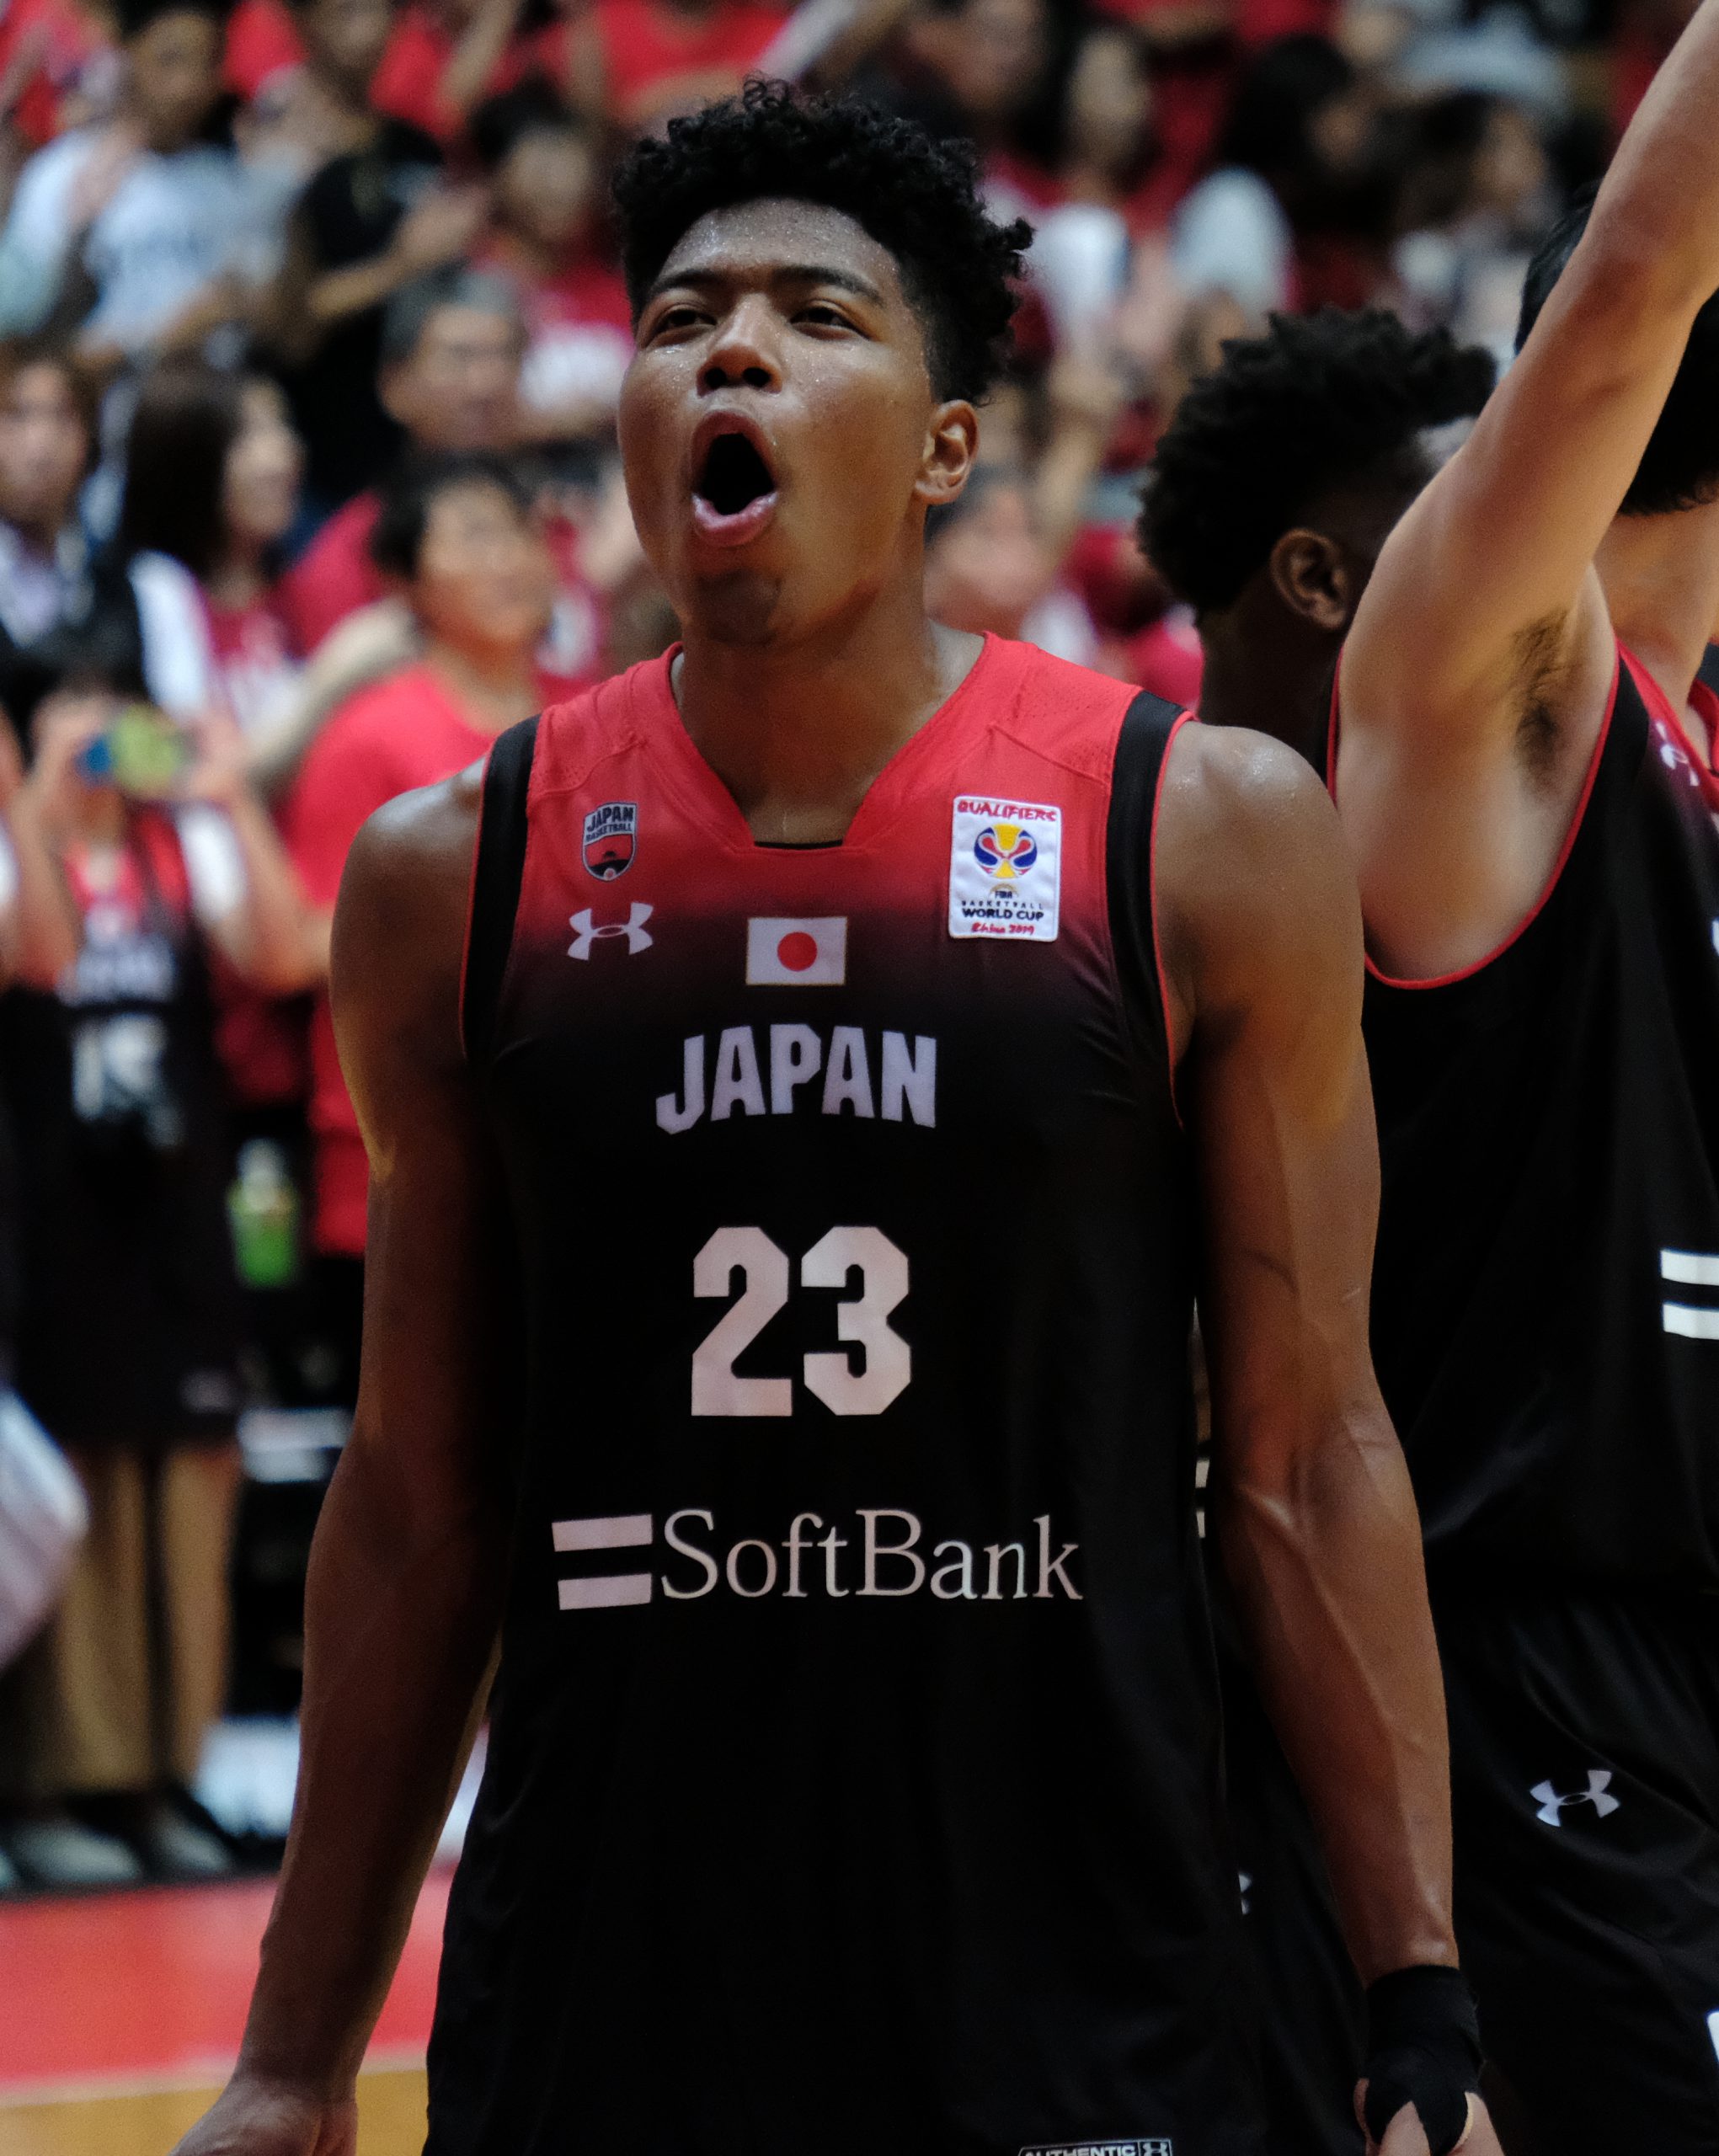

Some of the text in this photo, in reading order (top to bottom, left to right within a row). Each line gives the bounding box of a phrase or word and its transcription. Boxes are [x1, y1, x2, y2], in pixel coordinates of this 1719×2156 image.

[586, 806, 634, 832] JAPAN
[585, 823, 633, 842] BASKETBALL
[961, 899, 1044, 910] BASKETBALL
[962, 908, 1044, 921] WORLD CUP
[971, 921, 1006, 934] China
[655, 1023, 937, 1134] JAPAN
[690, 1225, 913, 1417] 23
[661, 1508, 1084, 1601] SoftBank
